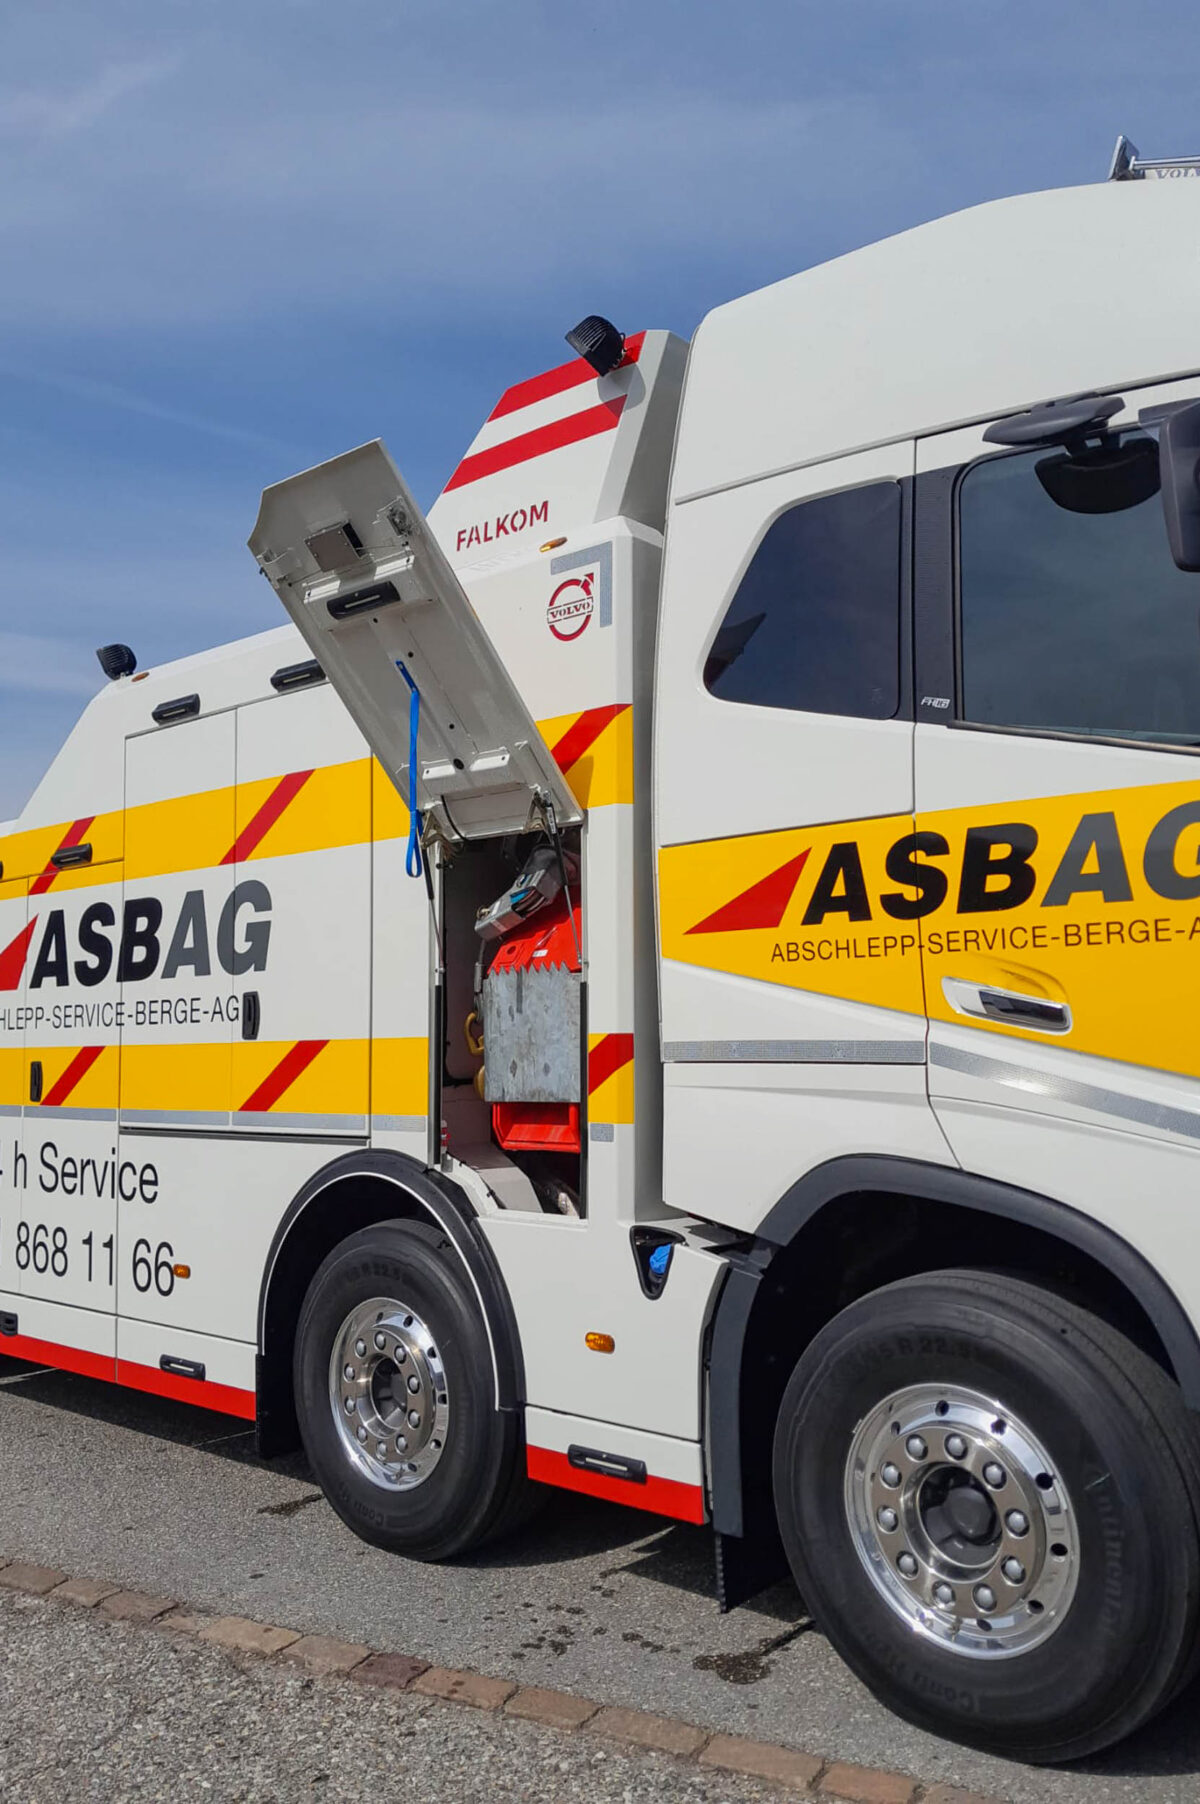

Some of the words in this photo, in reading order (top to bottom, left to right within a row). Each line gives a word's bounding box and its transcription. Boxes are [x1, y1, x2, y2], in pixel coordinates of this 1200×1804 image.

[456, 500, 549, 551] FALKOM
[550, 601, 591, 620] VOLVO
[29, 879, 273, 989] ASBAG
[14, 1140, 27, 1189] h
[38, 1141, 159, 1204] Service
[15, 1221, 68, 1277] 868
[82, 1231, 113, 1286] 11
[132, 1238, 175, 1297] 66
